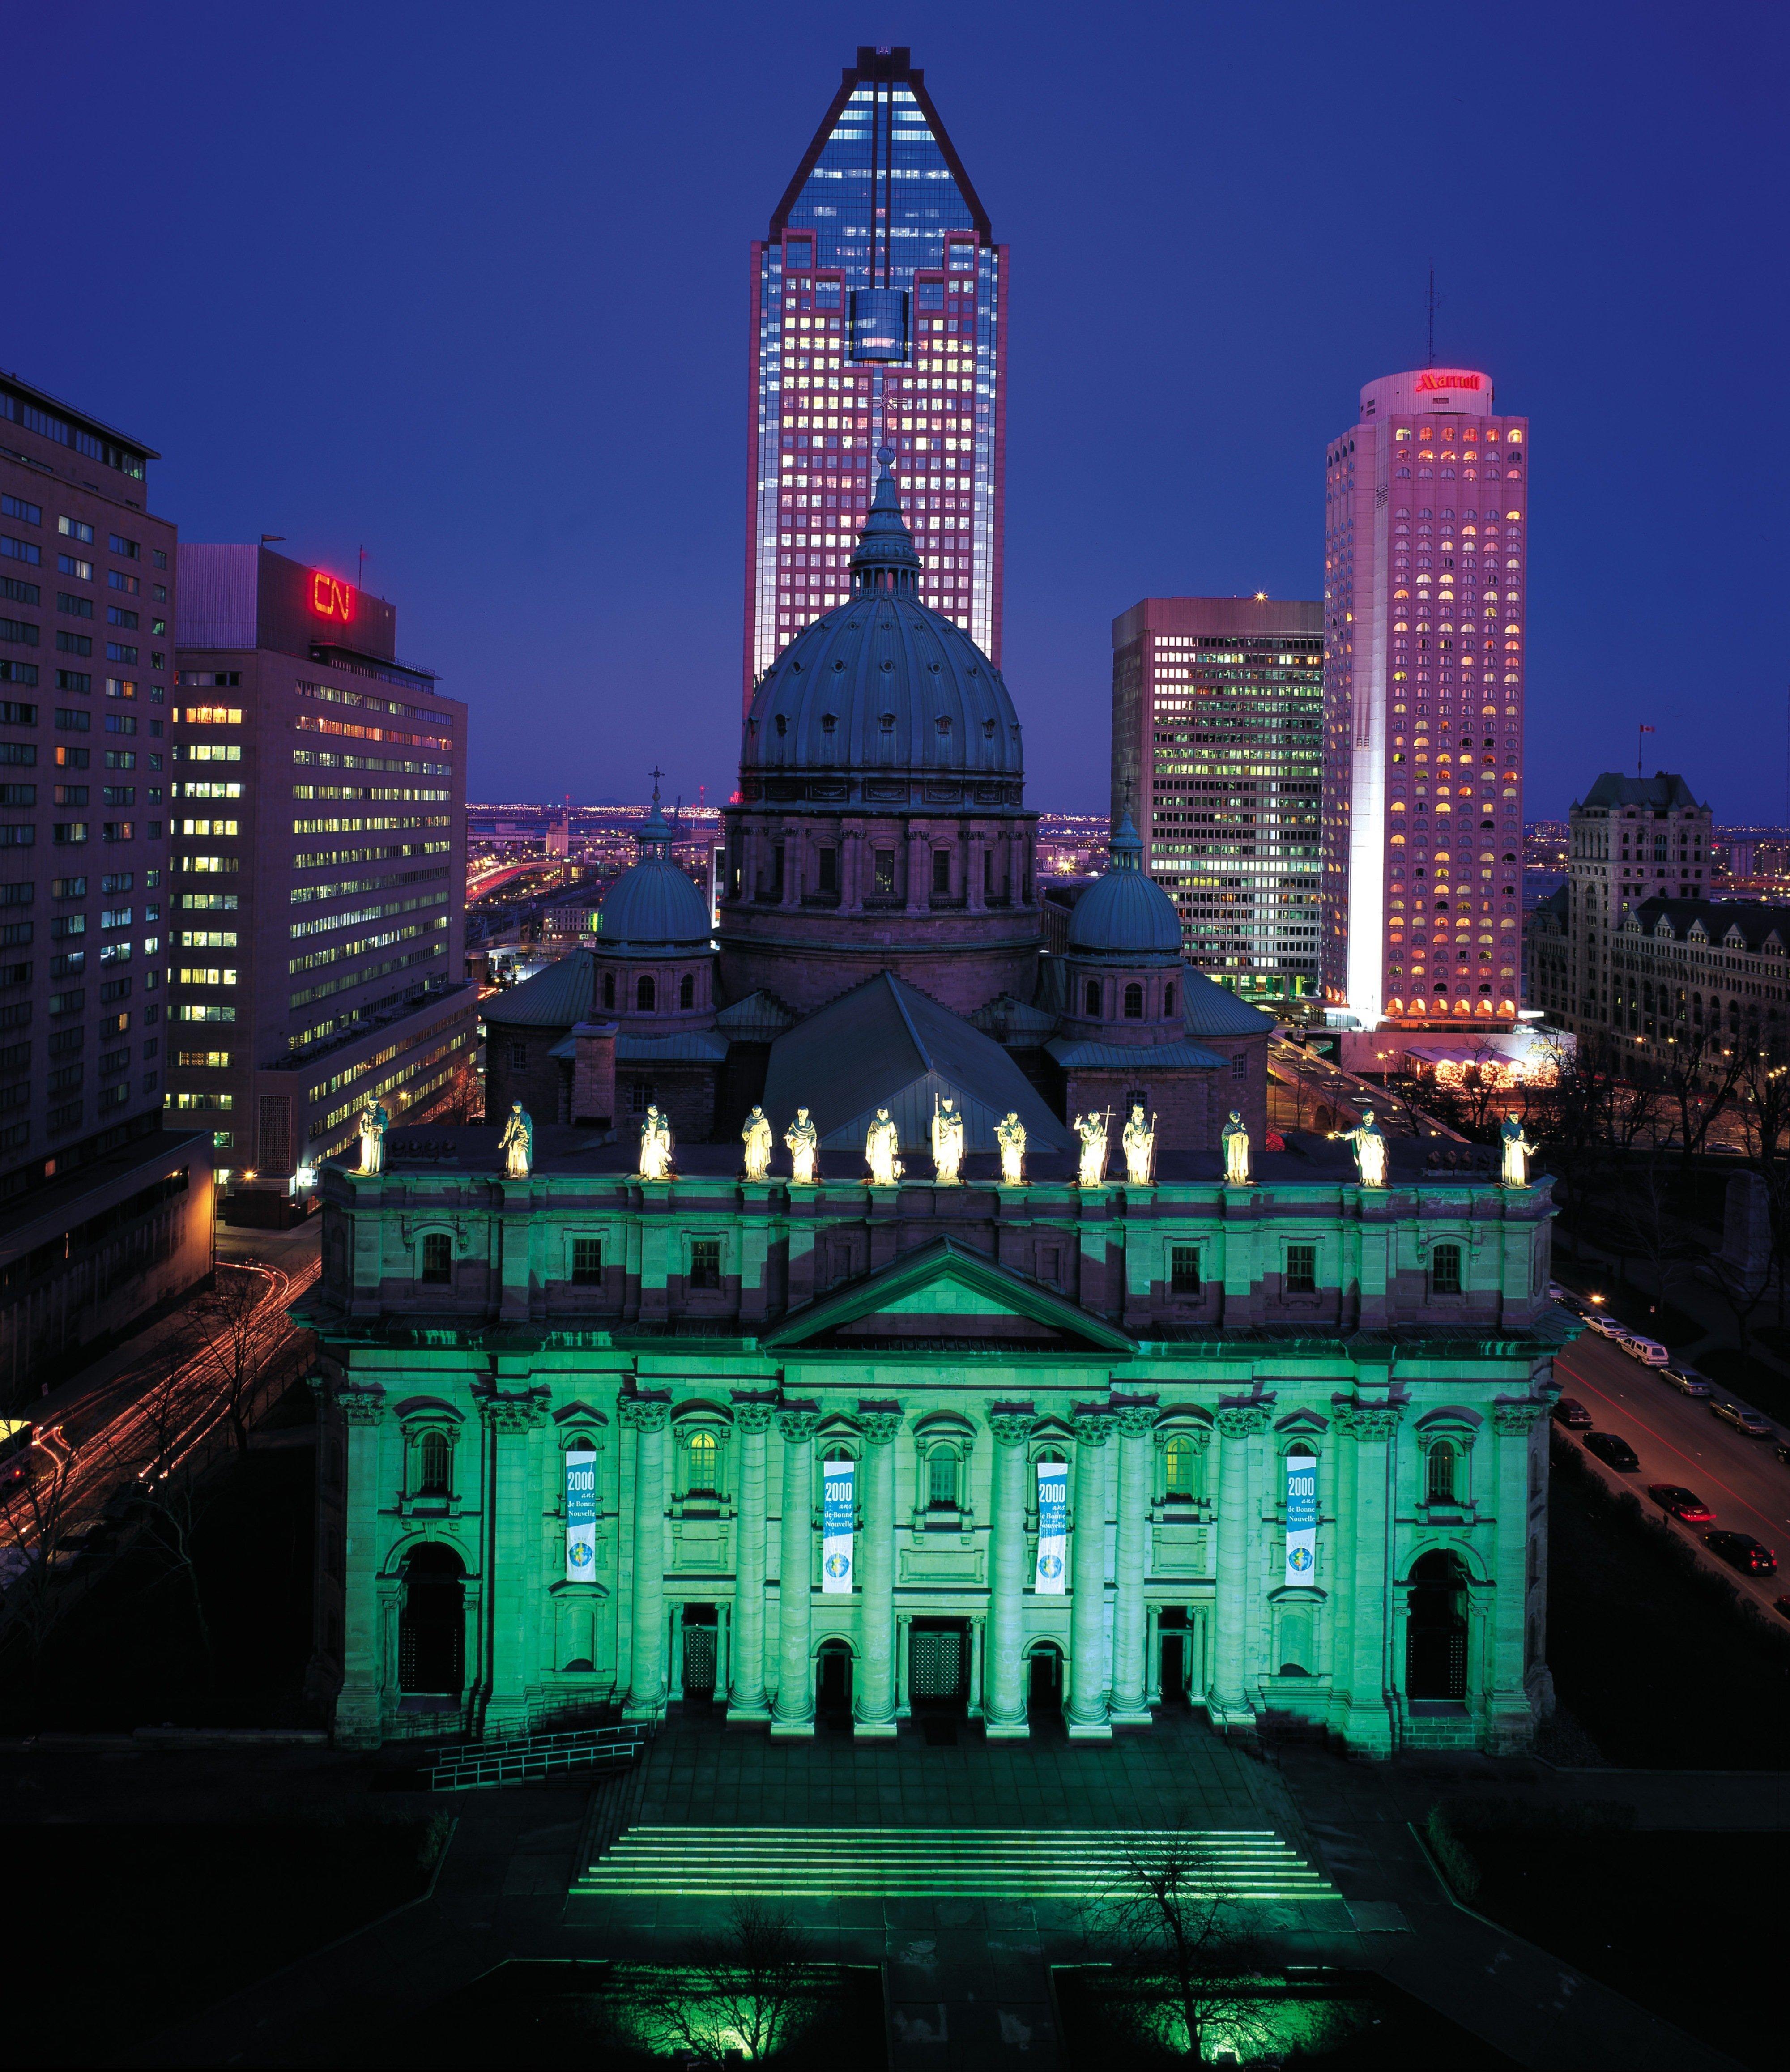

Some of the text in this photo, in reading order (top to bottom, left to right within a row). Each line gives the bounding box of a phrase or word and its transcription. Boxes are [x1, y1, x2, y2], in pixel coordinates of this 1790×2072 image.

[1416, 374, 1480, 392] Marriott
[315, 573, 349, 620] CN
[568, 1471, 594, 1490] 2000
[1288, 1477, 1314, 1496] 2000
[825, 1482, 852, 1501] 2000
[1039, 1484, 1065, 1502] 2000
